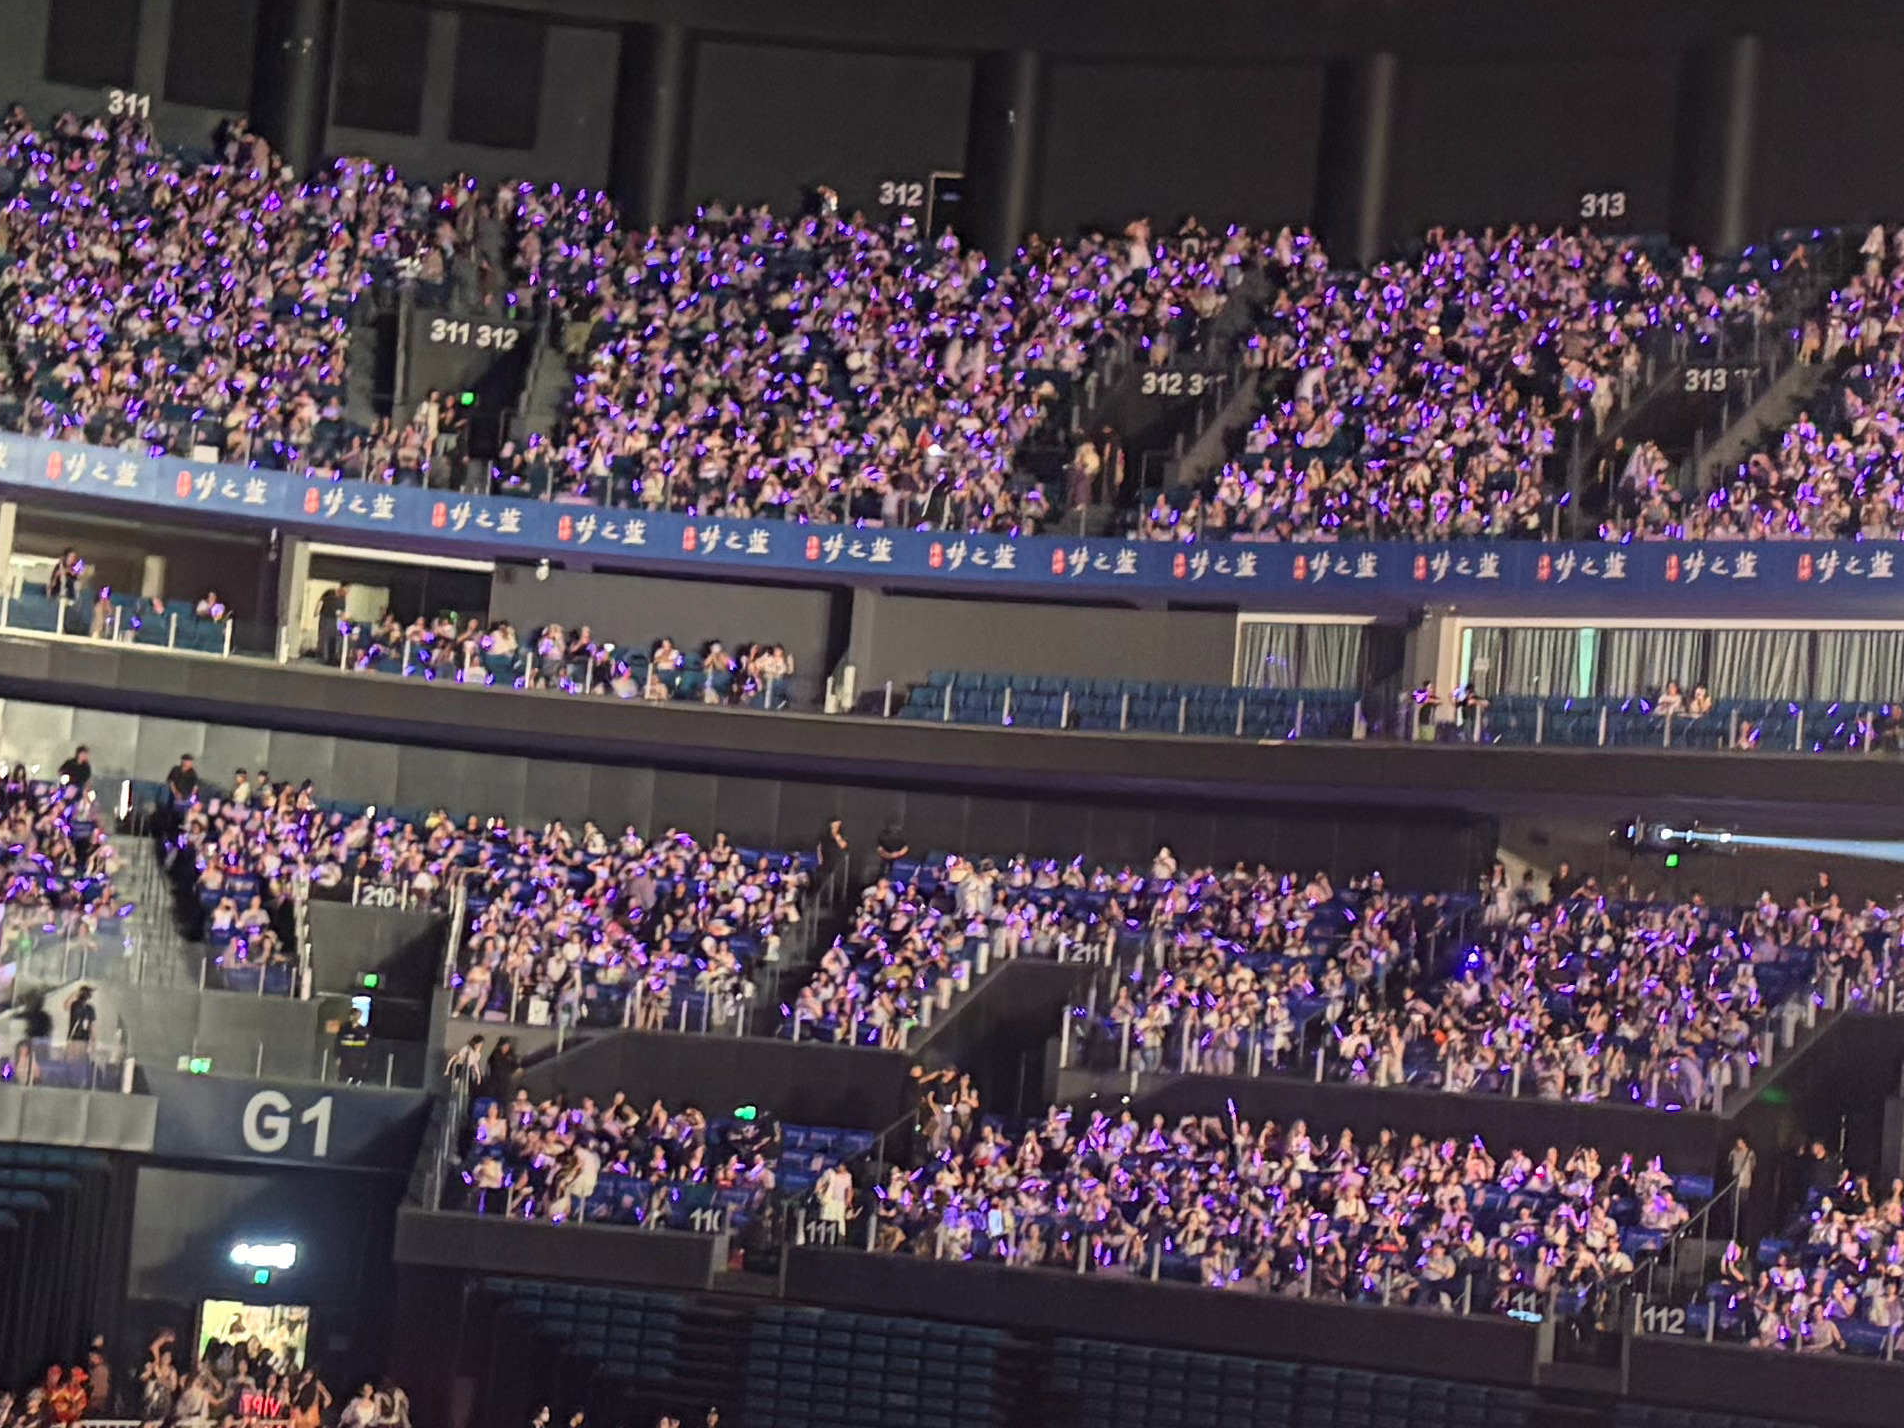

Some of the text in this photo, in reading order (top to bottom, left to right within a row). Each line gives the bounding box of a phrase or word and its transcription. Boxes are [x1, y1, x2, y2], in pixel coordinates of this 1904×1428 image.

[108, 89, 150, 118] 311
[879, 181, 924, 207] 312
[1581, 192, 1627, 218] 313
[430, 318, 519, 351] 311 312
[1141, 371, 1183, 395] 312
[1684, 368, 1727, 392] 313
[66, 454, 135, 487] 梦之蓝
[195, 472, 265, 505] 梦之蓝
[323, 488, 395, 520] 梦之蓝
[450, 502, 521, 534] 梦之蓝
[573, 514, 645, 546] 梦之蓝
[697, 526, 769, 555] 梦之蓝
[821, 534, 893, 564] 梦之蓝
[944, 540, 1015, 570] 梦之蓝
[1068, 548, 1137, 576] 梦之蓝
[1190, 551, 1257, 579] 梦之蓝
[1308, 552, 1377, 580] 梦之蓝
[1429, 554, 1499, 582] 梦之蓝
[1555, 554, 1625, 581] 梦之蓝
[1684, 552, 1757, 580] 梦之蓝
[1816, 550, 1892, 581] 梦之蓝
[362, 882, 395, 907] 210
[1072, 942, 1100, 962] 211
[242, 1089, 333, 1158] G1
[1511, 1290, 1540, 1312] 11
[1640, 1305, 1686, 1334] 112
